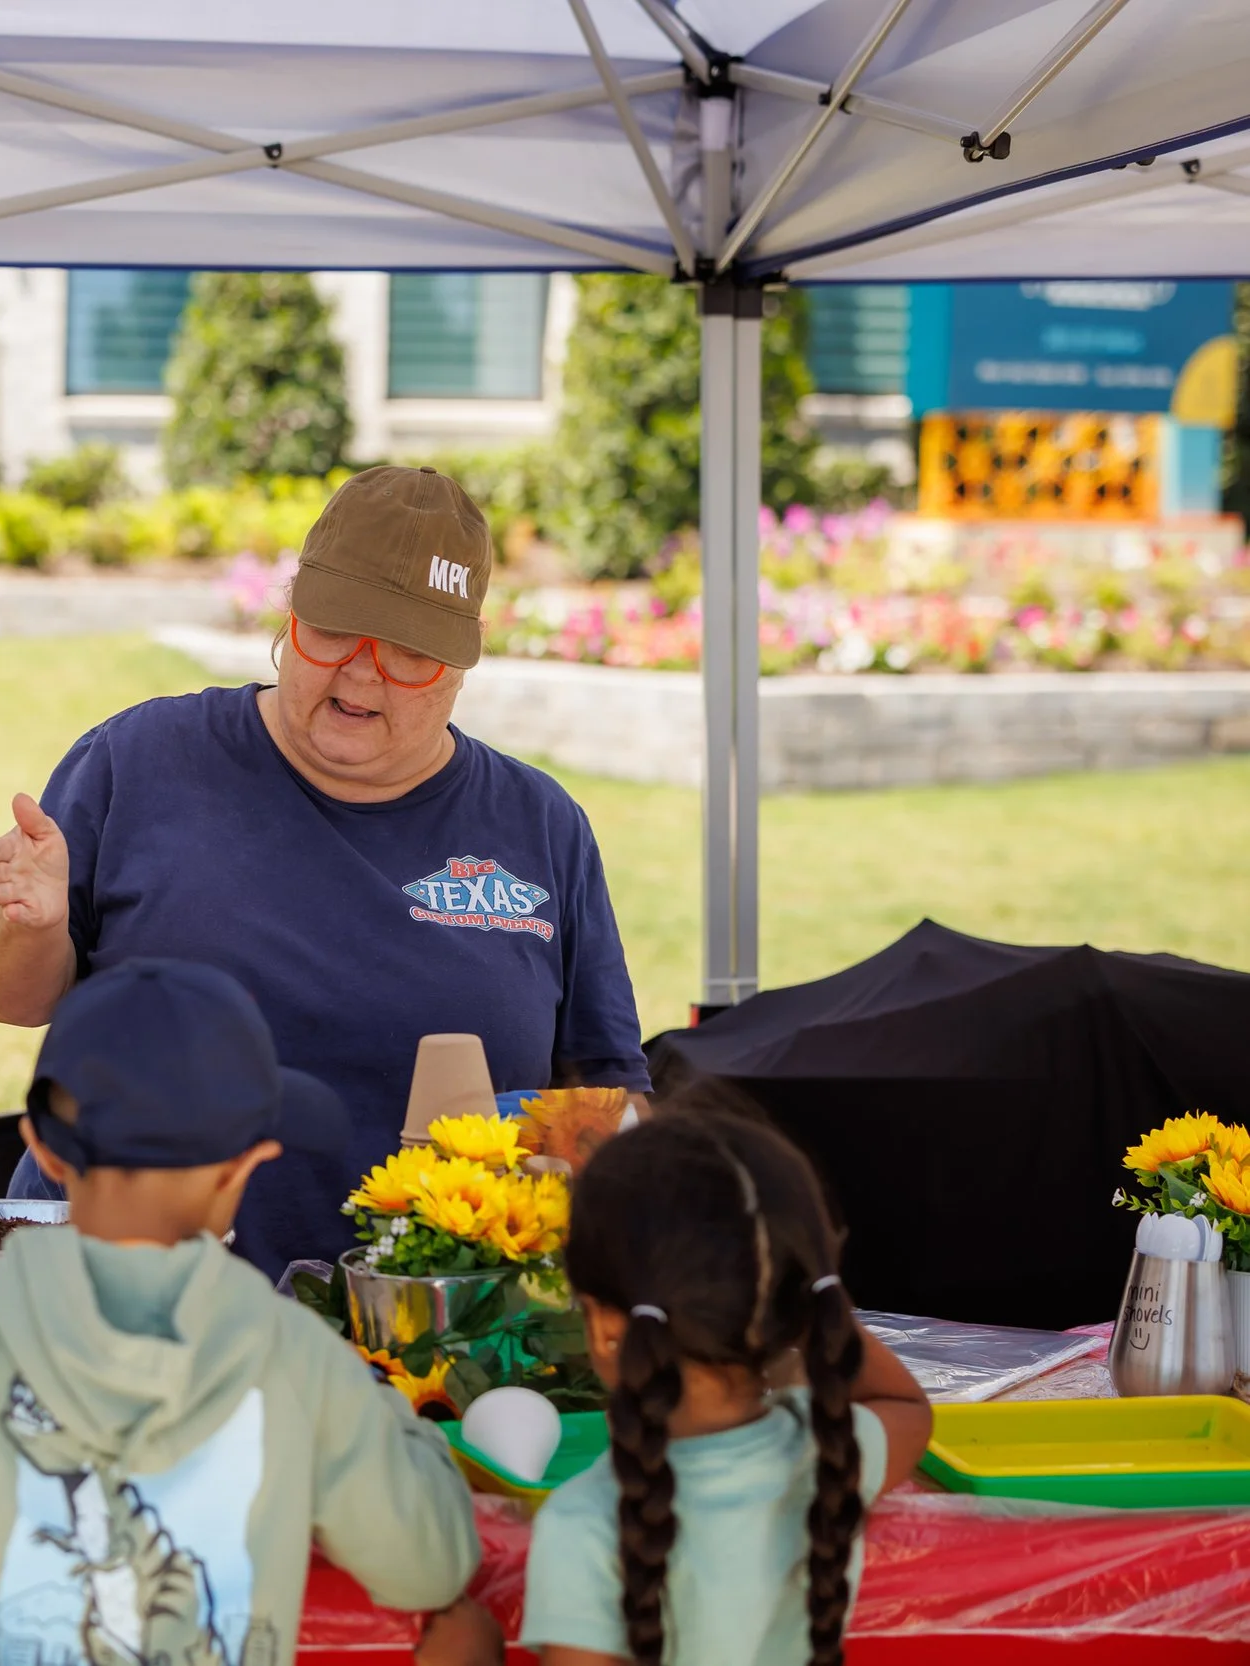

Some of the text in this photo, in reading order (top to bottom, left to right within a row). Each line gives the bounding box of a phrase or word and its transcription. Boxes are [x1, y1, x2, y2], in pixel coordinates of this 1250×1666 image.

[450, 860, 495, 878] BIG
[420, 876, 533, 913] TEXAS
[414, 909, 552, 938] CUSTOM EVENTS
[1128, 1281, 1161, 1302] mini
[1123, 1304, 1173, 1326] shovels
